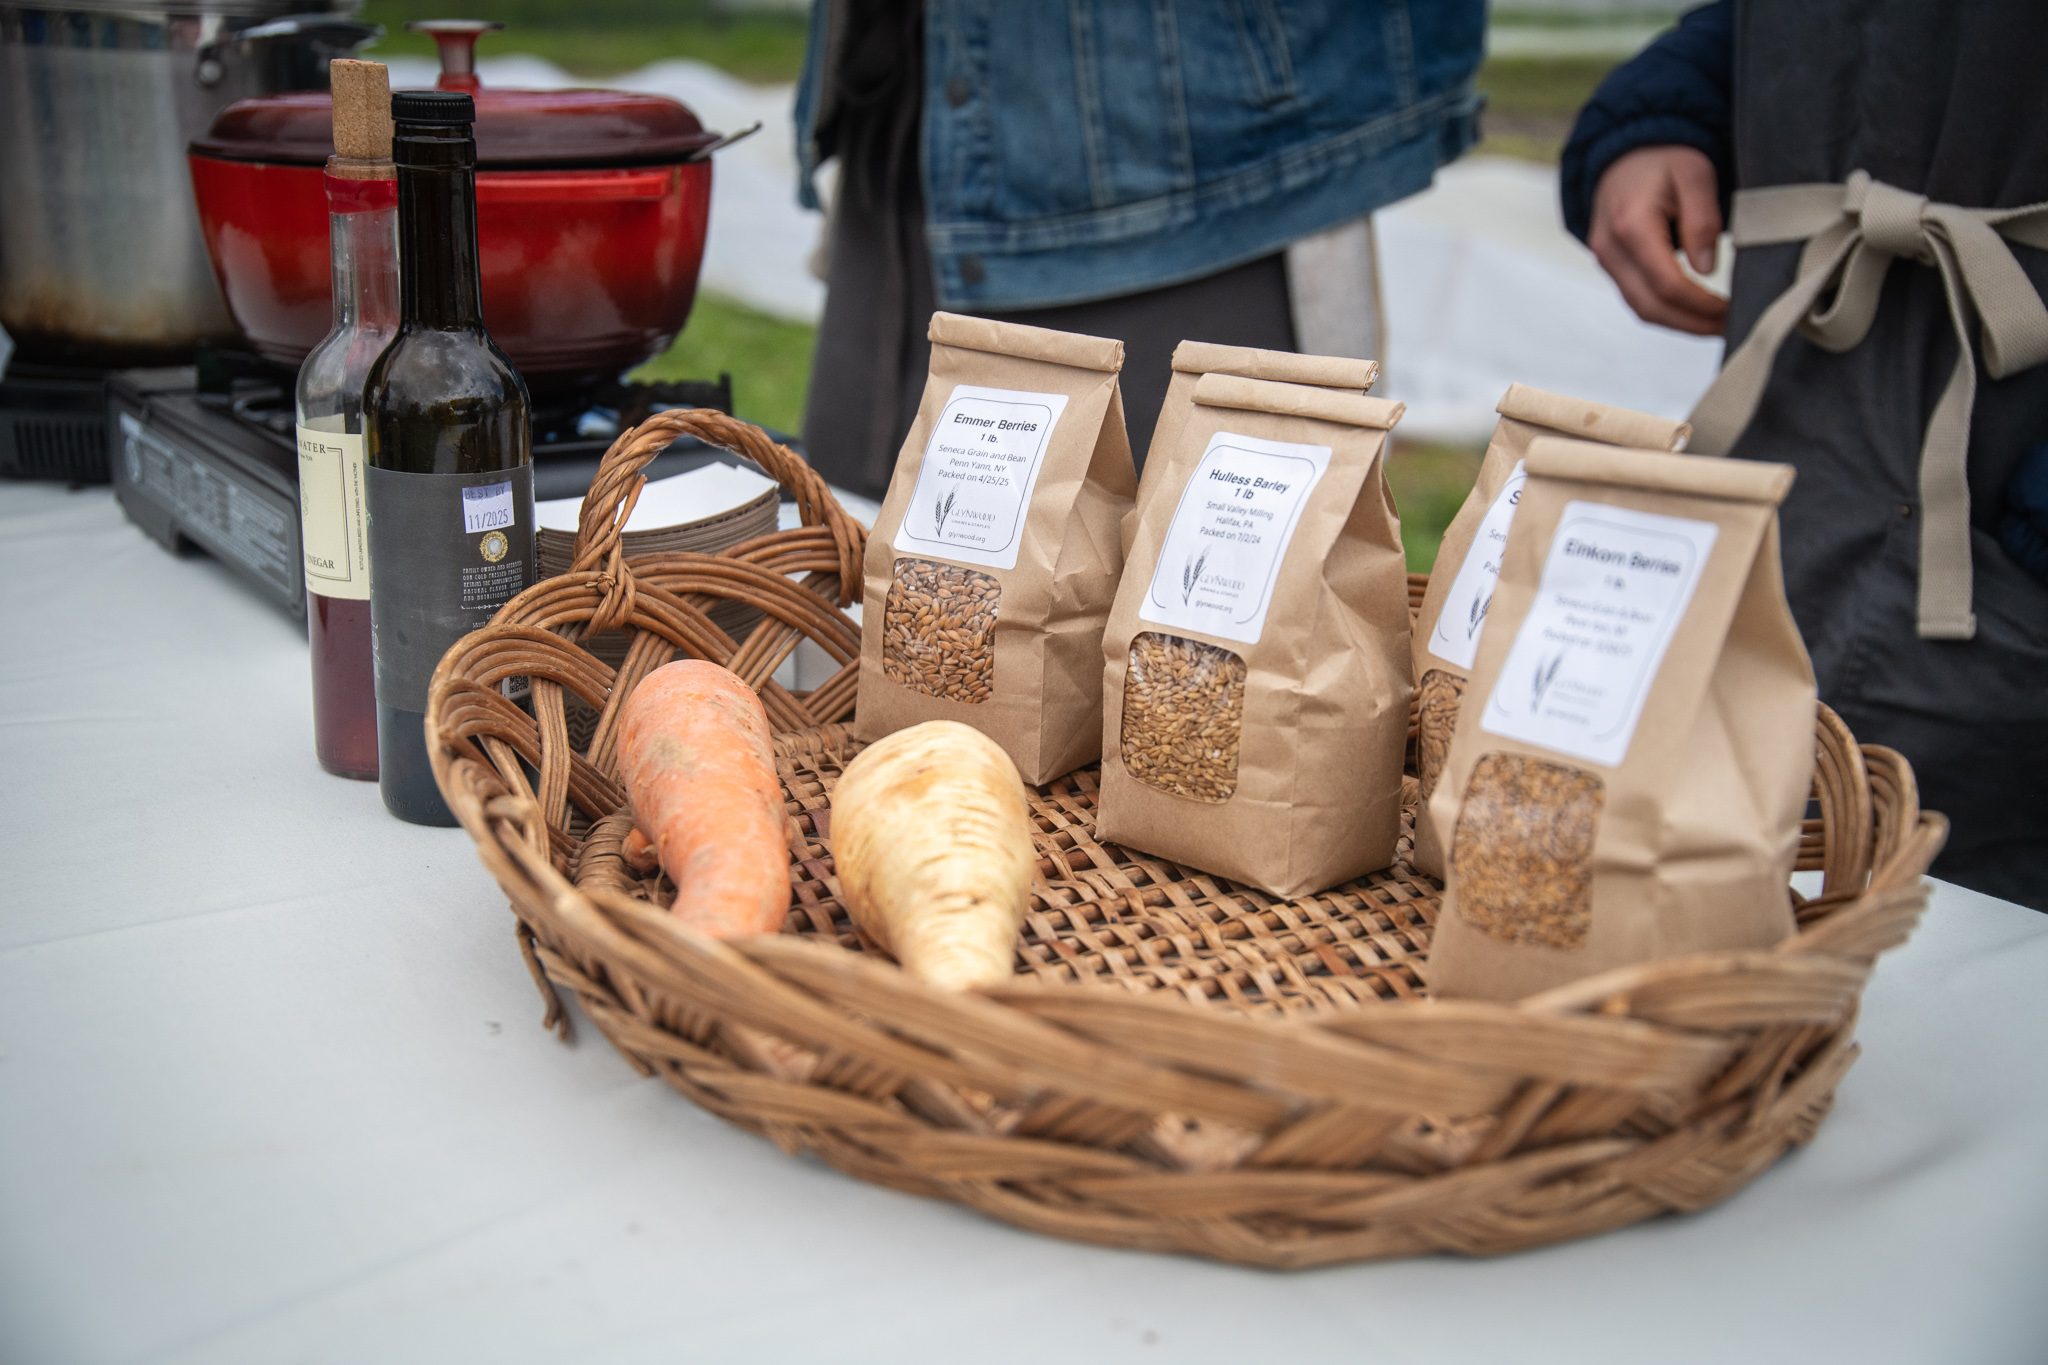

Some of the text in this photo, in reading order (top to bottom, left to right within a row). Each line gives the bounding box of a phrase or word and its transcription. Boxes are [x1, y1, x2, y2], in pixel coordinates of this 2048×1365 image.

[954, 413, 1037, 432] Emmer Berries
[988, 434, 998, 443] lb.
[938, 444, 1026, 463] Seneca Grain and Bean
[950, 458, 970, 468] Penn
[971, 461, 992, 472] Yann,
[938, 469, 1009, 486] Packed on 4/25/25
[1209, 469, 1290, 494] Hulless Barley
[465, 485, 505, 499] BEST BY
[1234, 488, 1254, 500] 1 lb
[468, 509, 508, 529] 11/2025
[1206, 501, 1274, 521] Small Valley Milling
[1216, 516, 1254, 529] Halifax, PA
[1200, 526, 1261, 544] Packed on 7/2/24
[1564, 538, 1680, 576] Einkorn Berries
